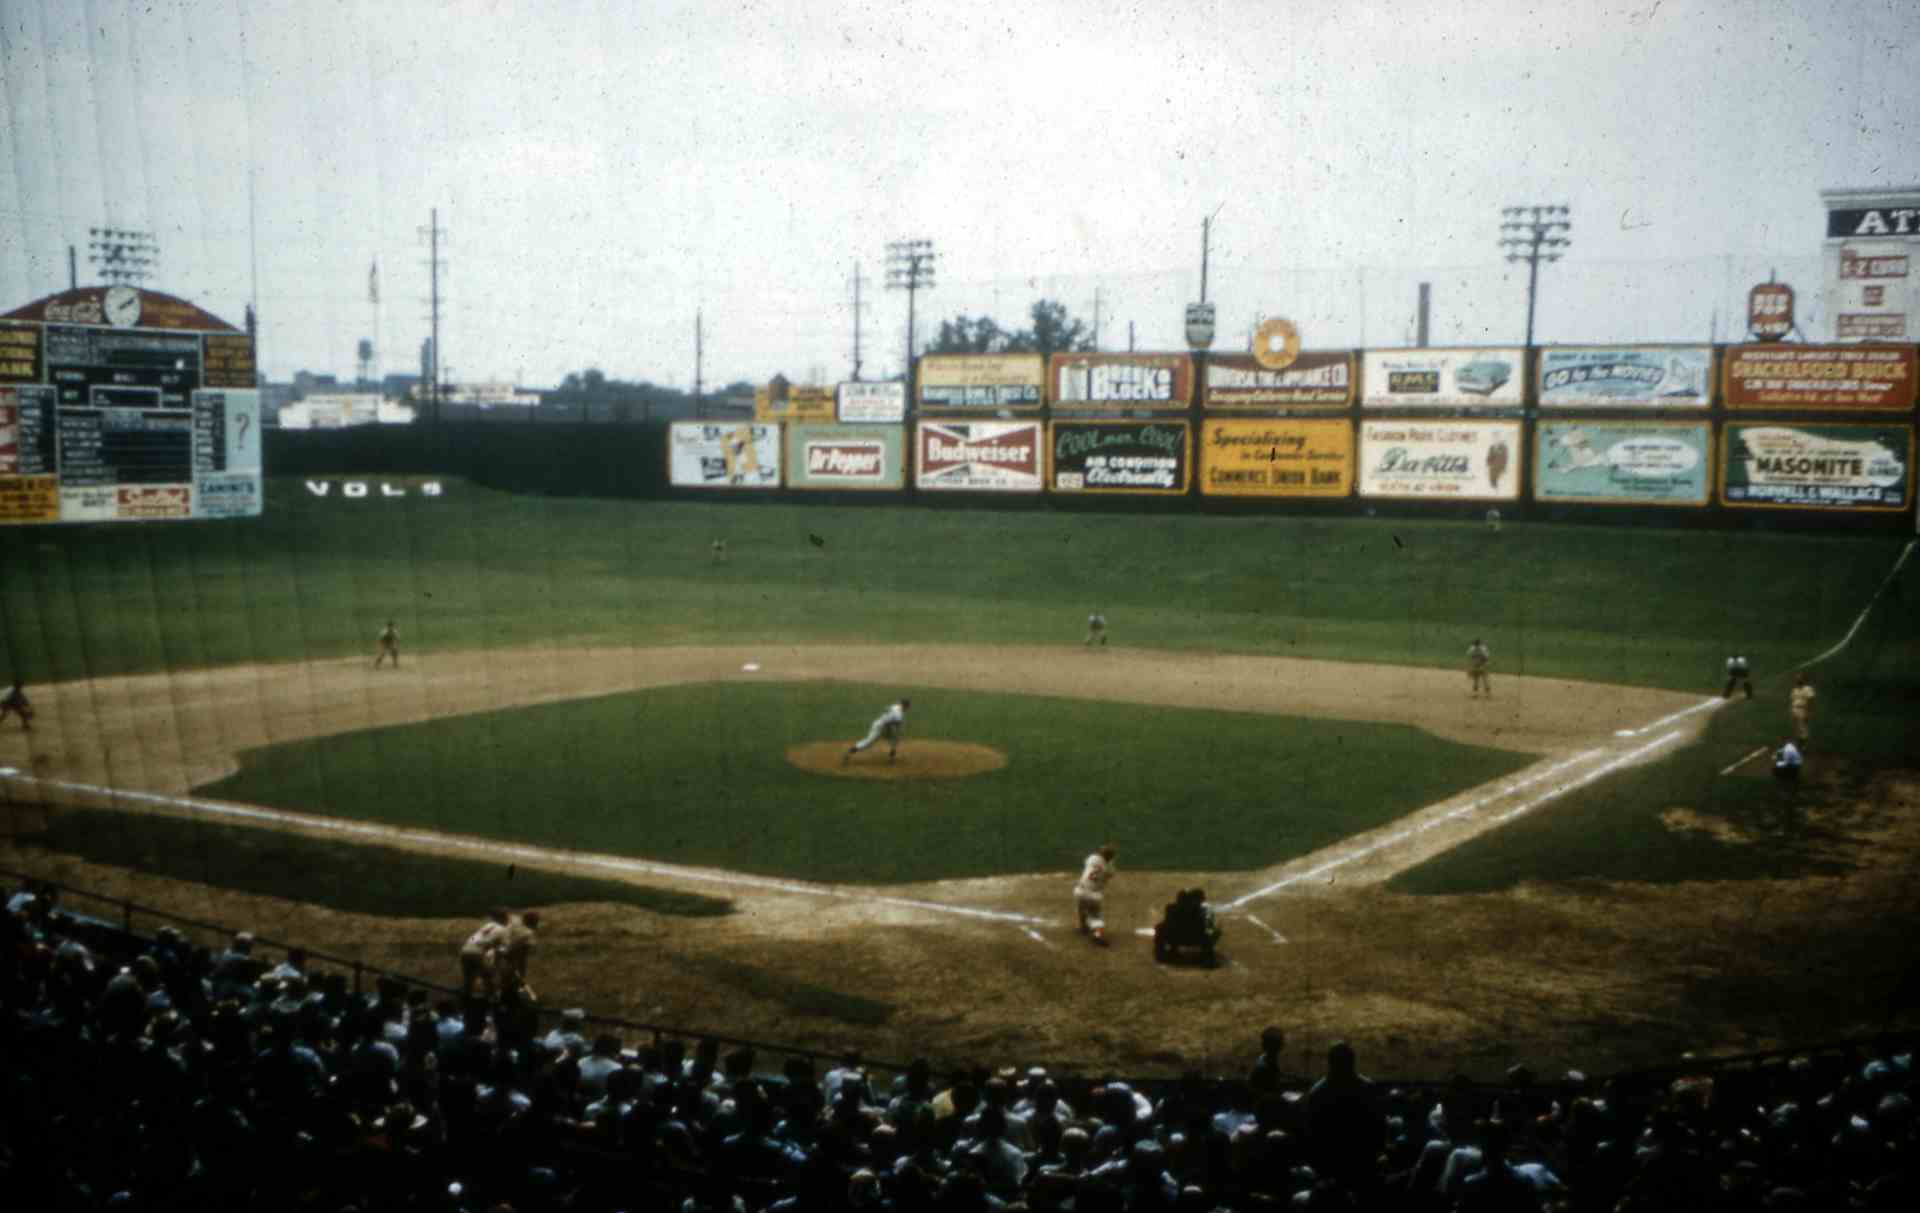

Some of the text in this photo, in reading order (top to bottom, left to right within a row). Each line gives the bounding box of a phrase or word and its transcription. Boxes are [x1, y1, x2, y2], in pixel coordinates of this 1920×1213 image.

[1212, 427, 1306, 449] Specializing
[927, 437, 1030, 462] Budweiser
[809, 449, 878, 474] Dr Pepper
[1757, 457, 1862, 475] MASONITE
[305, 480, 442, 497] VOLS
